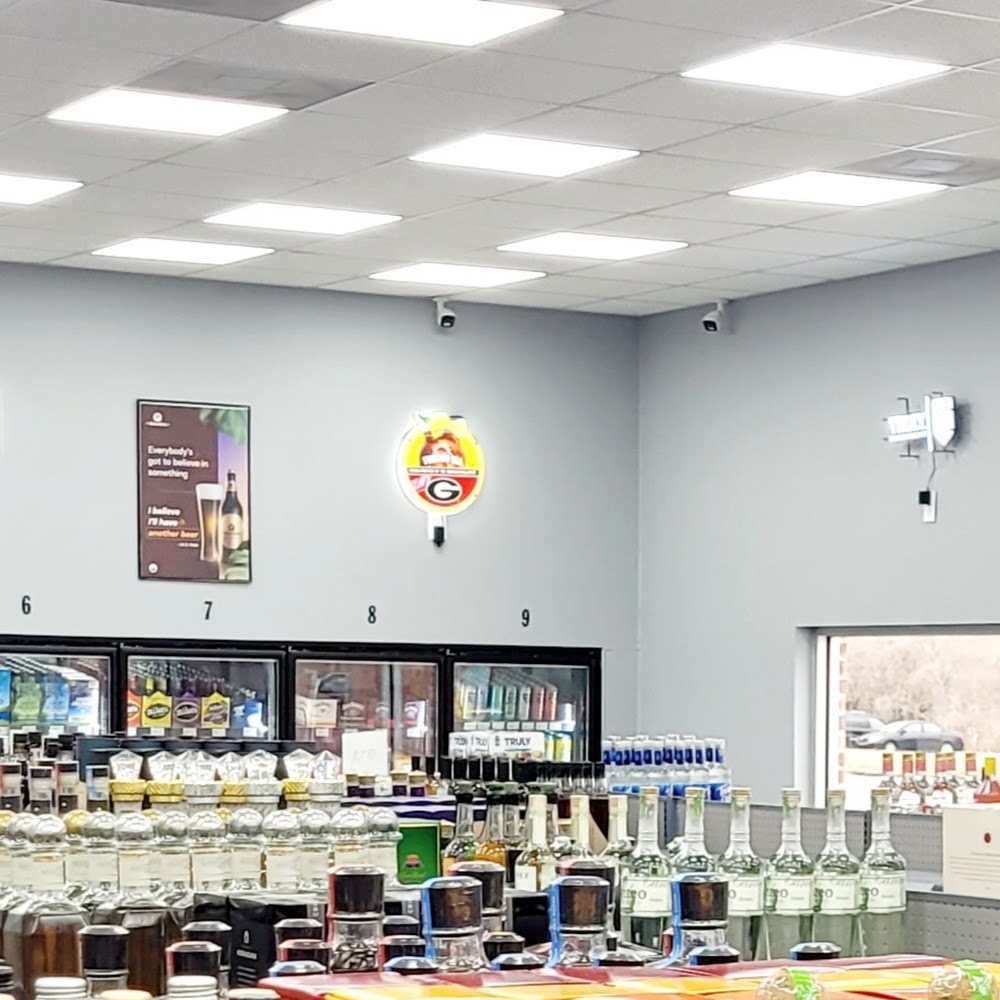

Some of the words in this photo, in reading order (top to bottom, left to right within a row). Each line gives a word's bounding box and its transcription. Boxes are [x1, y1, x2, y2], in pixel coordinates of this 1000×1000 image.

[148, 445, 193, 457] Everybody's
[148, 459, 161, 467] got
[173, 459, 200, 468] believe
[201, 460, 209, 468] in
[148, 470, 188, 480] something
[428, 480, 460, 501] G
[153, 507, 181, 516] believe
[159, 518, 179, 527] have
[148, 530, 179, 538] another
[181, 530, 199, 538] beer
[22, 596, 31, 616] 6
[204, 601, 213, 621] 7
[368, 605, 377, 625] 8
[521, 609, 530, 628] 9
[504, 737, 531, 746] TRULY
